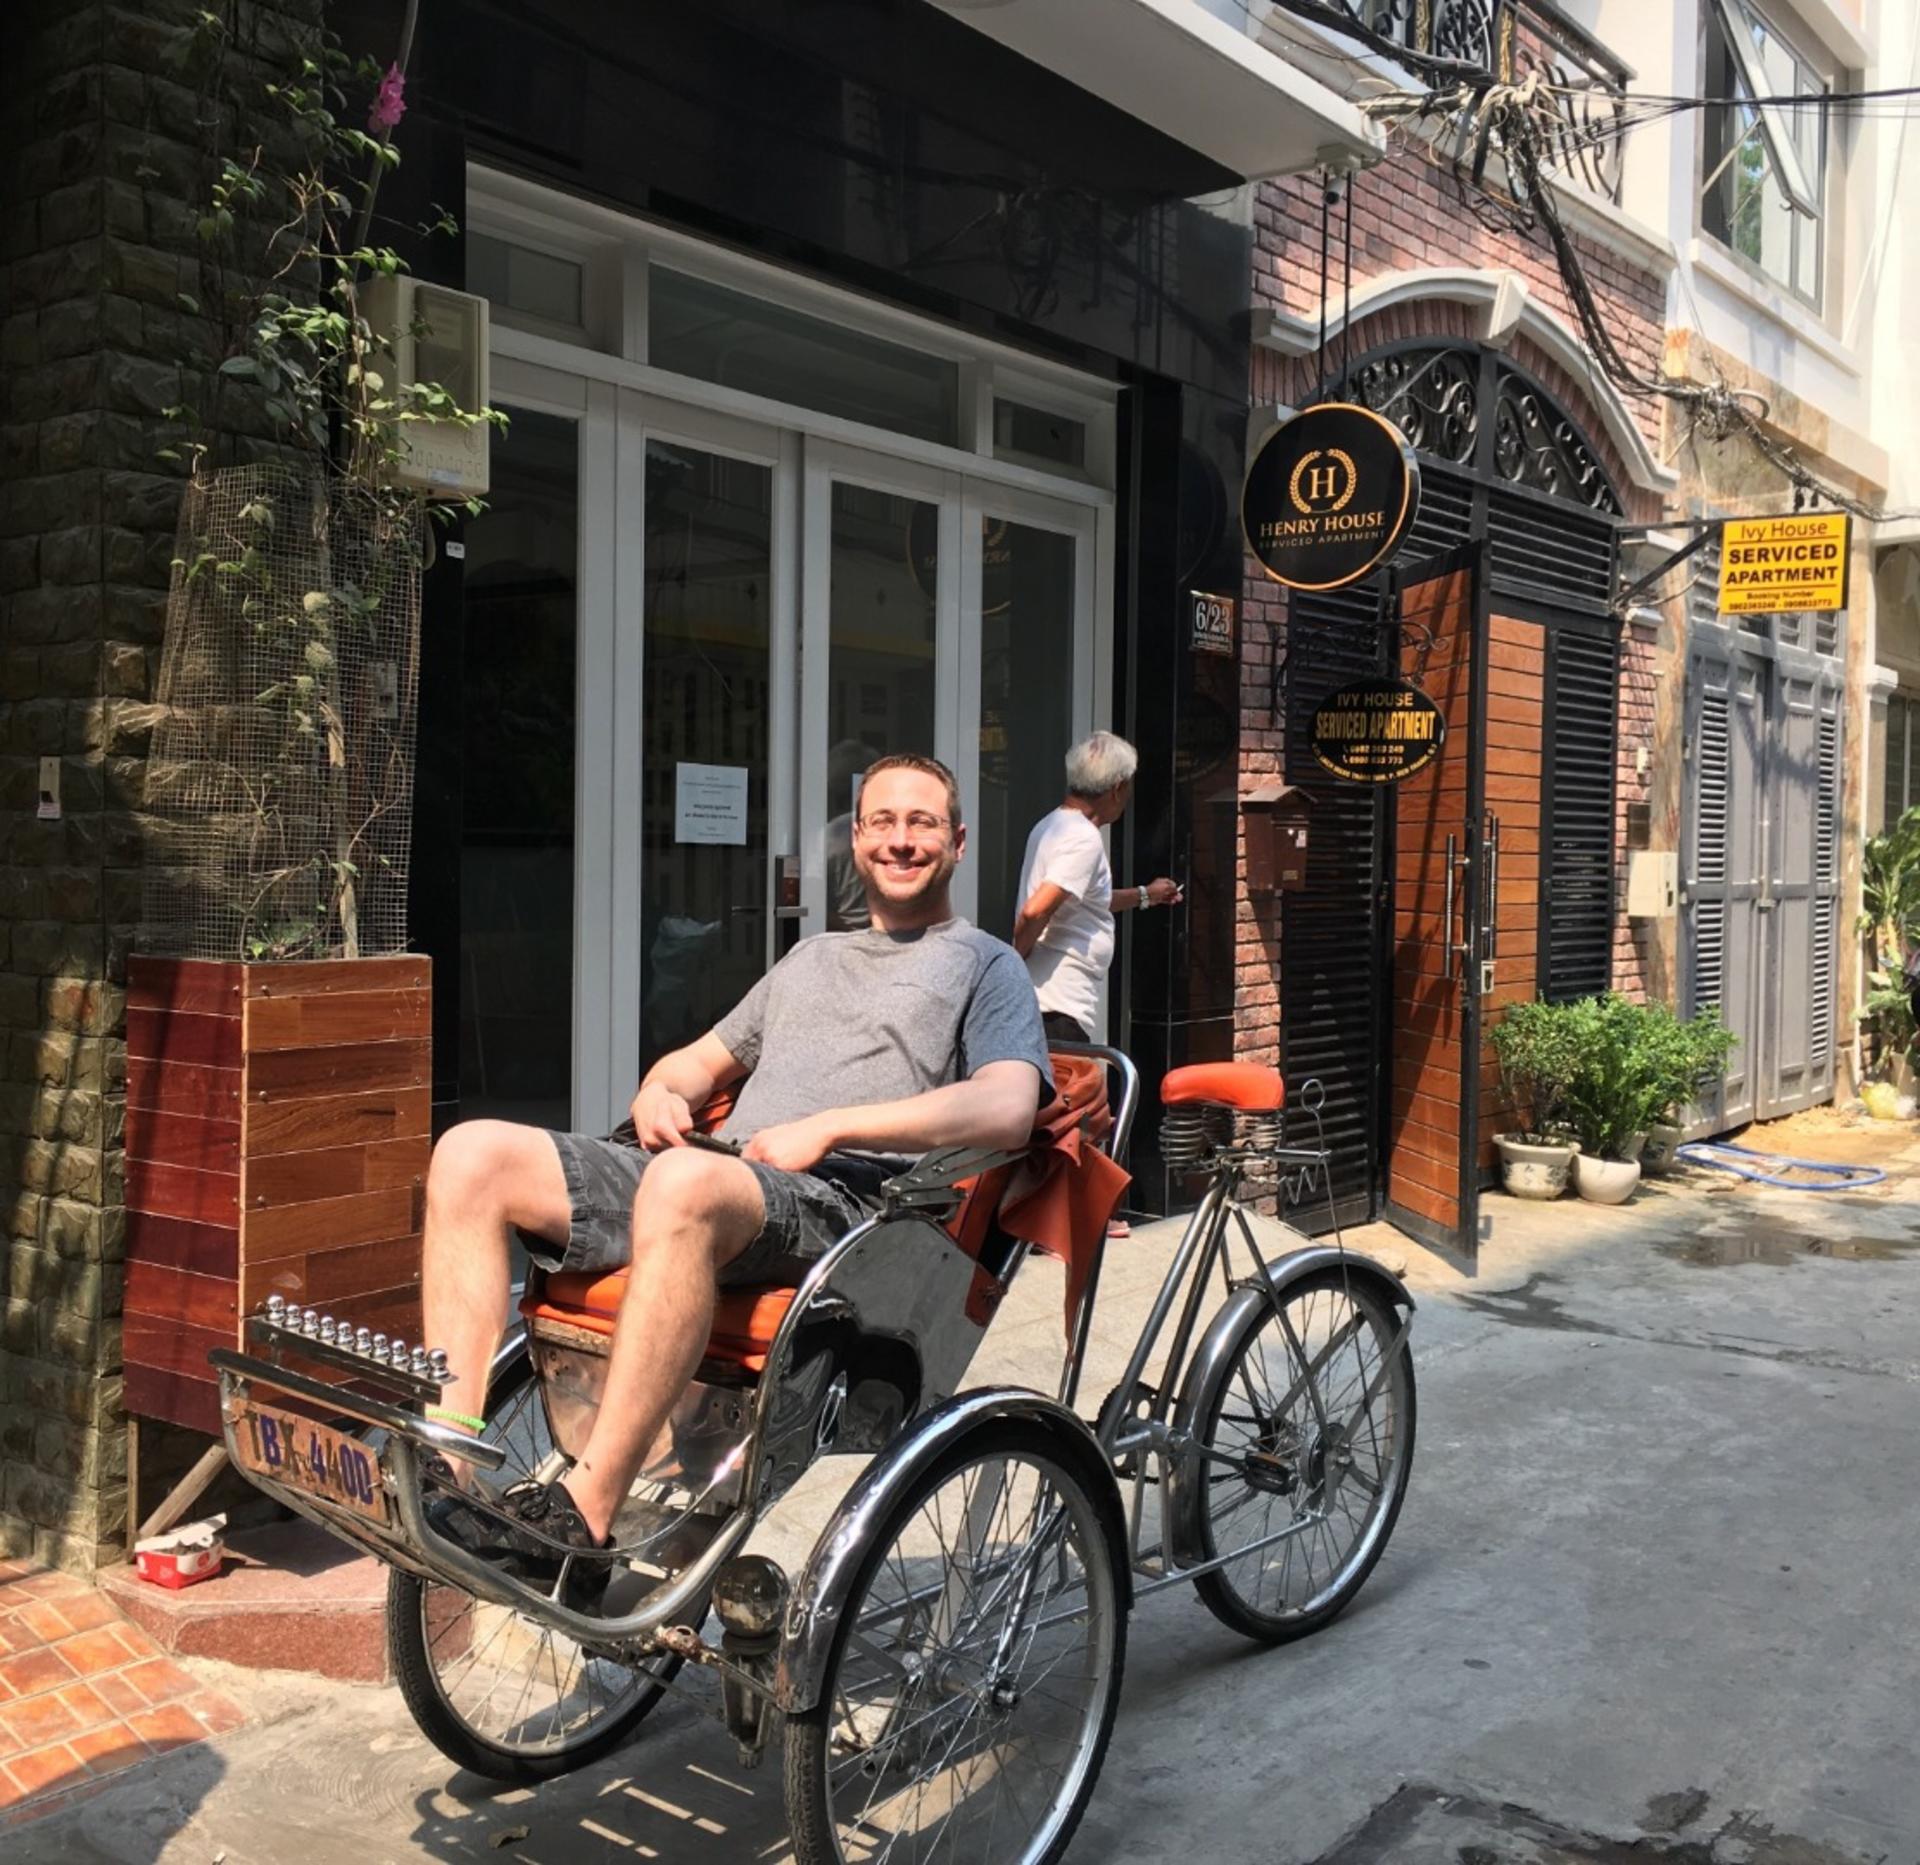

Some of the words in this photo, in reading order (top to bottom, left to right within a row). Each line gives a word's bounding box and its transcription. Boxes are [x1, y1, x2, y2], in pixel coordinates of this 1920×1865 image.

[1309, 466, 1336, 500] H
[1260, 517, 1319, 537] HENRY
[1325, 511, 1385, 531] HOUSE
[1741, 524, 1766, 542] Ivy
[1771, 521, 1828, 537] House
[1319, 530, 1384, 545] APARTMENT
[1729, 544, 1837, 564] SERVICED
[1726, 566, 1838, 584] APARTMENT
[1747, 592, 1780, 600] Booking
[1783, 590, 1815, 598] Number
[1195, 601, 1231, 634] 6/23
[1337, 693, 1360, 707] IVY
[1364, 692, 1414, 707] HOUSE
[1316, 711, 1367, 739] SERVICED
[1369, 711, 1436, 740] APARTMENT
